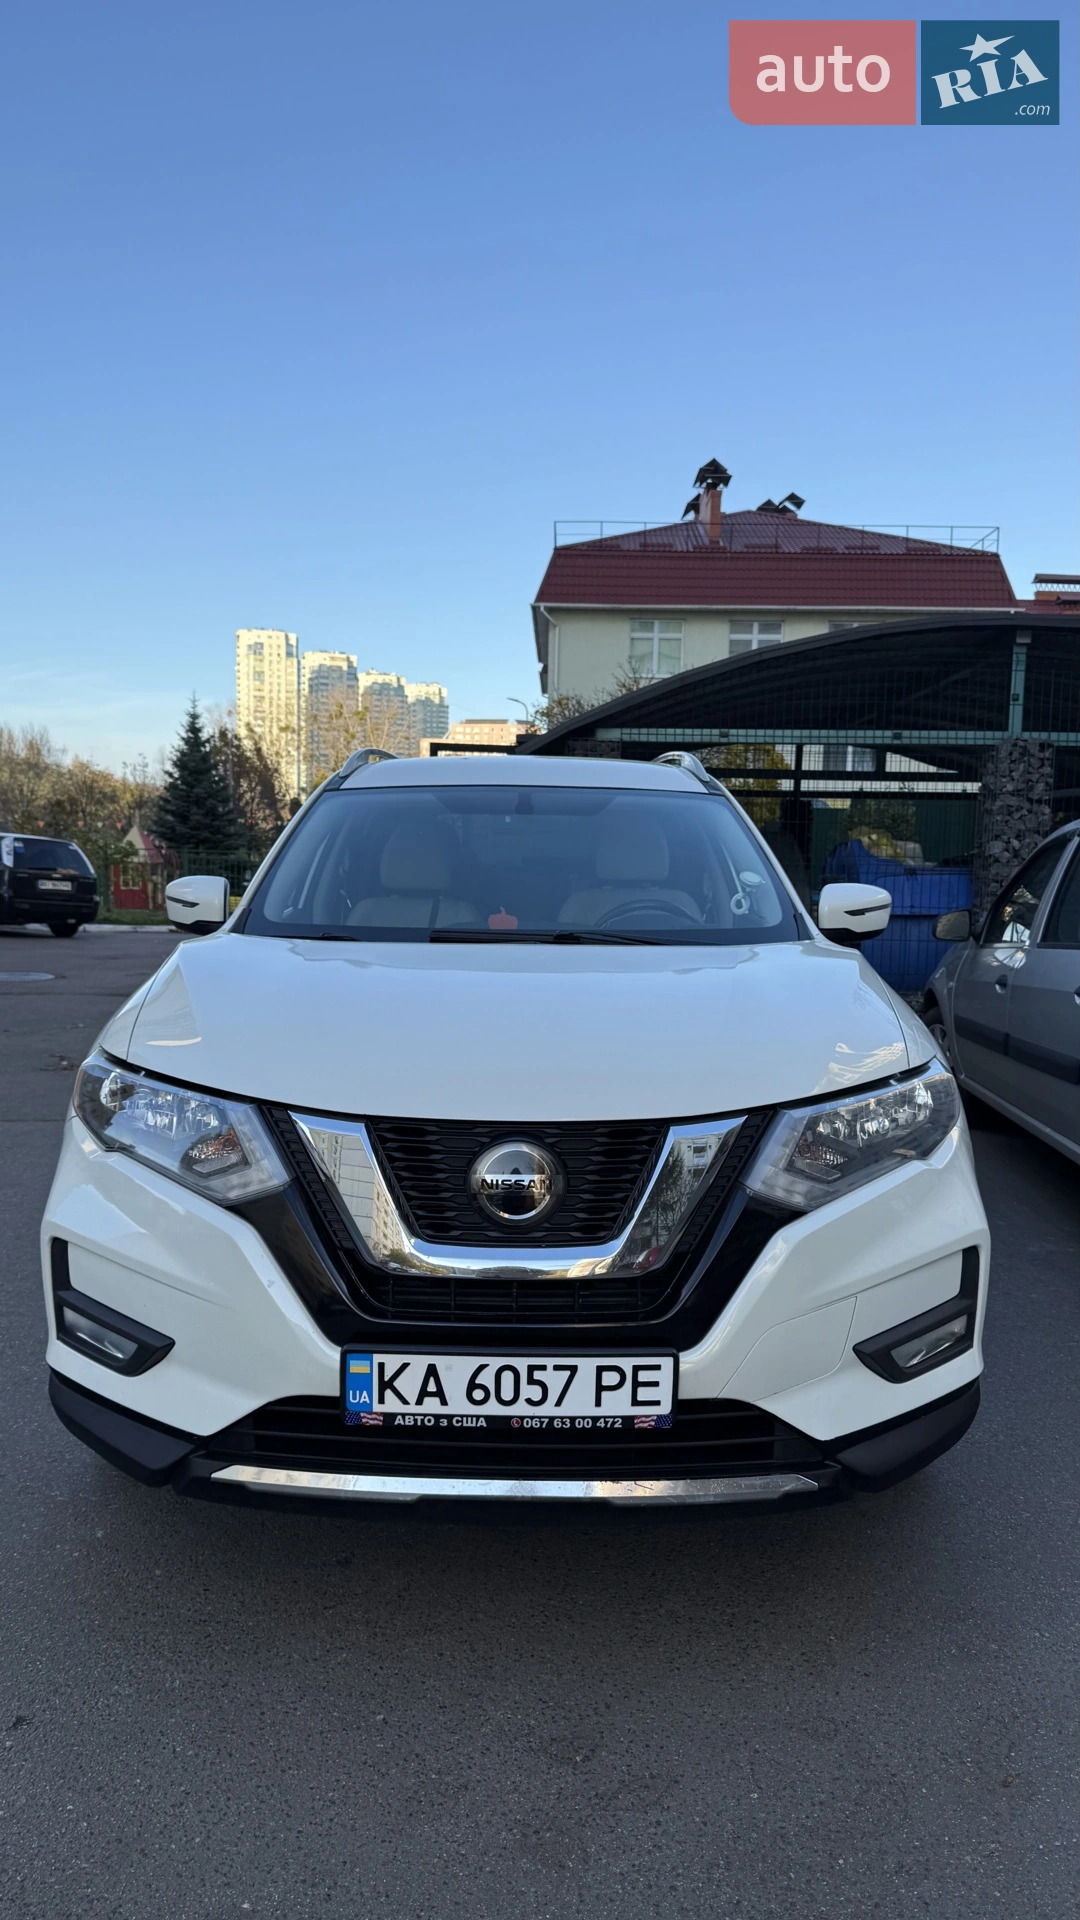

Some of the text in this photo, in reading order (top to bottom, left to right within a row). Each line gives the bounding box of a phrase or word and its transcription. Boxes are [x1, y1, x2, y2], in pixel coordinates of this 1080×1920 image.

[480, 1178, 552, 1191] NISSAN
[377, 1361, 662, 1408] KA 6057 PE
[349, 1390, 370, 1404] UA
[394, 1415, 435, 1426] АВТО
[452, 1416, 488, 1427] США
[523, 1417, 622, 1429] 067 63 00 472
